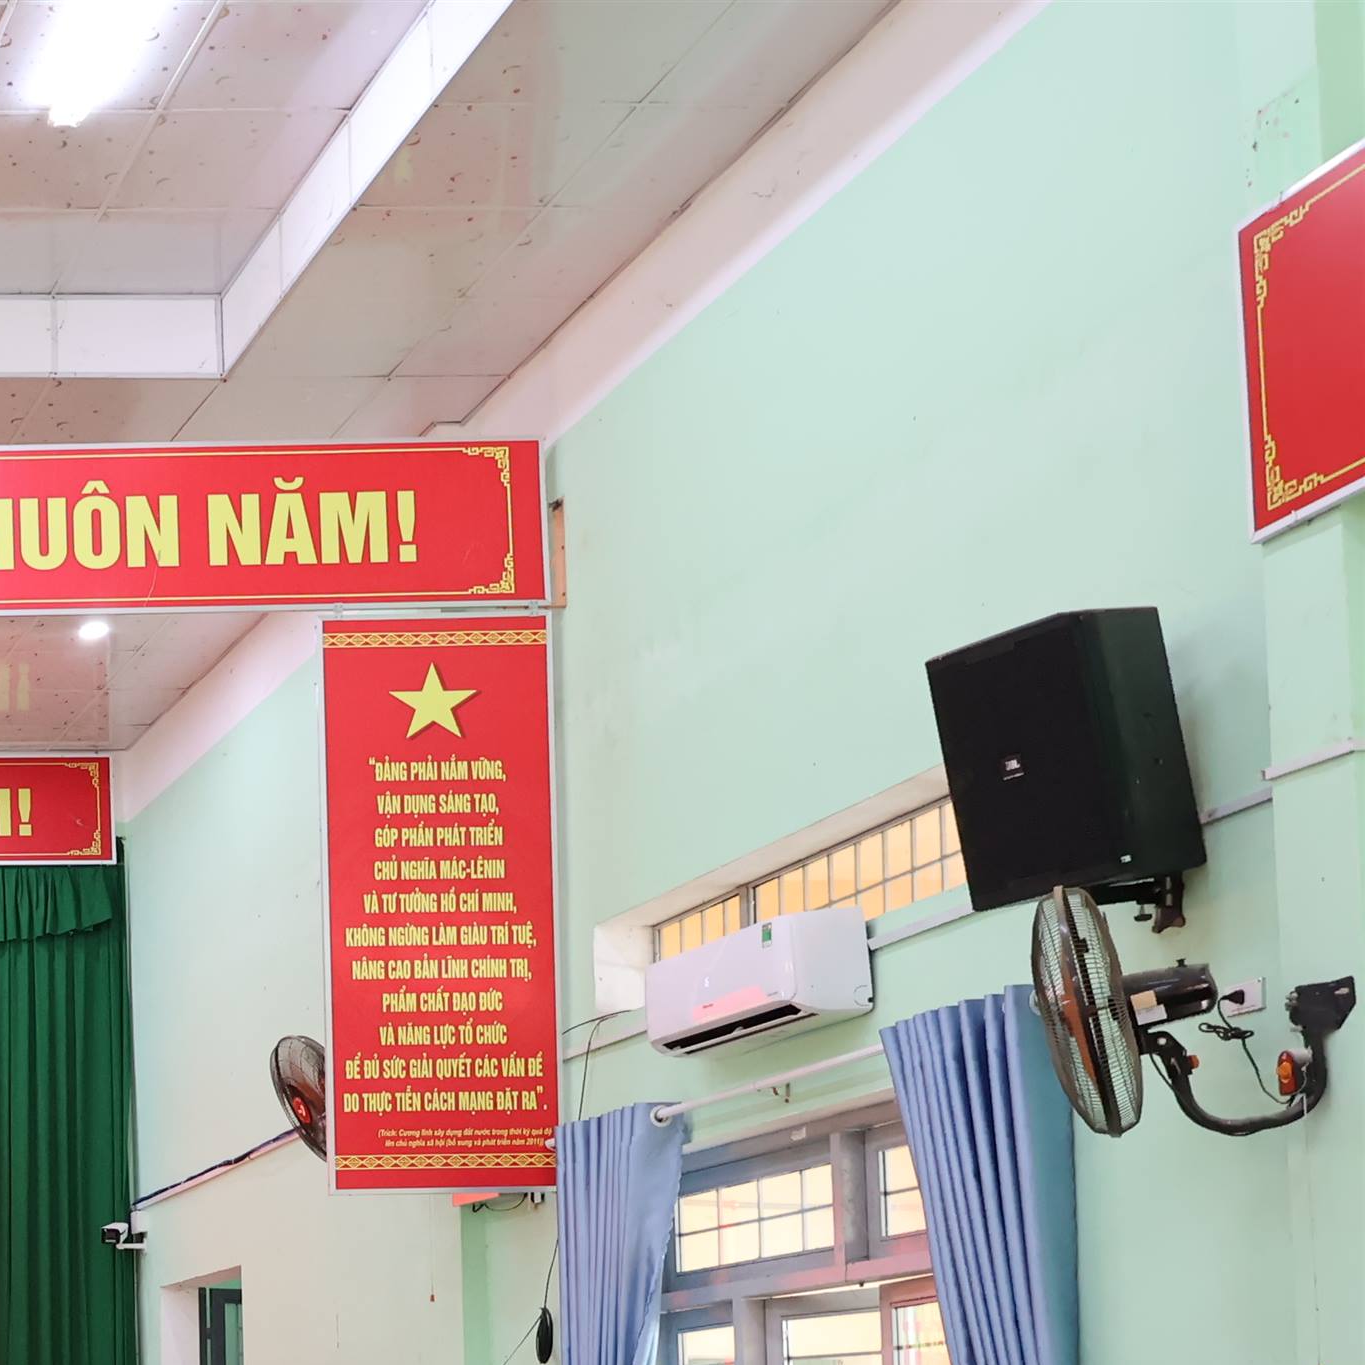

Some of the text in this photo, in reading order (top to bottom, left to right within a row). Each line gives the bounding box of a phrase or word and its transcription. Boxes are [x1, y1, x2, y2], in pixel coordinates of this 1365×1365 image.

[207, 476, 418, 566] NĂM!
[368, 754, 507, 782] “ĐẢNG PHẢI NẮM VỮNG,
[376, 790, 500, 819] VẬN DỤNG SÁNG TẠO,
[374, 820, 504, 848] GÓP PHẦN PHÁT TRIỂN
[374, 854, 506, 881] CHỦ NGHĨA MÁC-LÊNIN
[363, 886, 517, 914] VÀ TƯ TƯỞNG HỒ CHÍ MINH,
[345, 920, 537, 949] KHÔNG NGỪNG LÀM GIÀU TRÍ TUỆ,
[352, 953, 532, 982] NÂNG CAO BẢN LĨNH CHÍNH TRỊ,
[382, 985, 503, 1016] PHẨM CHẤT ĐẠO ĐỨC
[379, 1017, 508, 1049] VÀ NĂNG LỰC TỔ CHỨC
[345, 1051, 544, 1080] ĐỂ ĐỦ SỨC GIẢI QUYẾT CÁC VẤN ĐỀ
[343, 1085, 548, 1117] DO THỰC TIỄN CÁCH MẠNG ĐẶT RA”.
